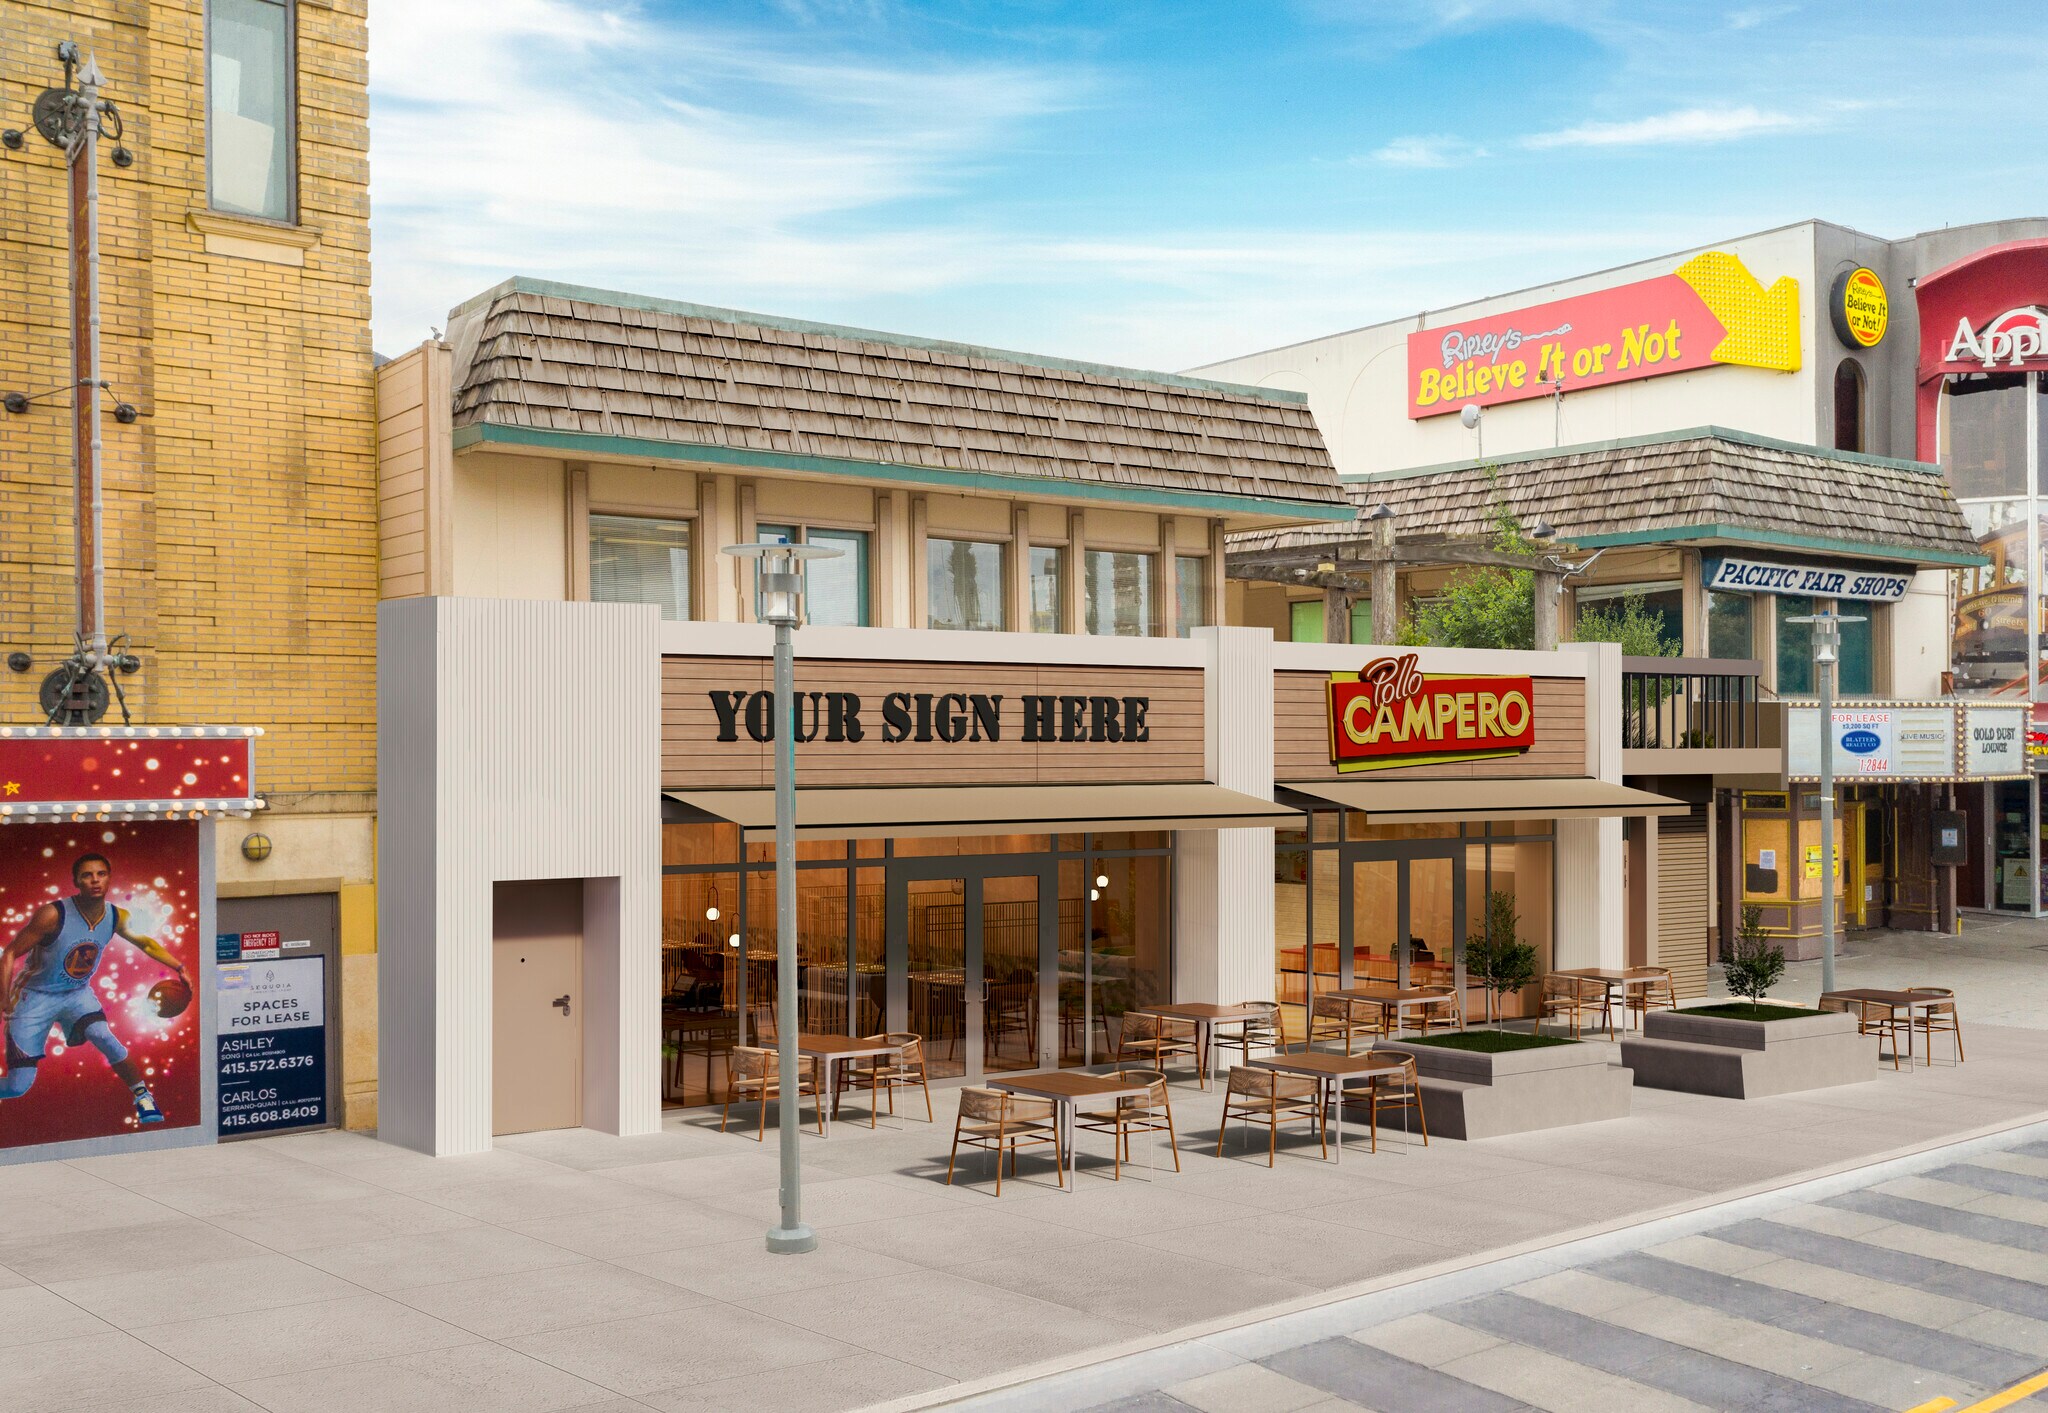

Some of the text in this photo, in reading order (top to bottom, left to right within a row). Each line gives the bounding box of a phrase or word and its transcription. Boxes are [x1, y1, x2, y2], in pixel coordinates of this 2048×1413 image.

[1847, 294, 1886, 317] Believe It
[1852, 315, 1880, 332] or Not!
[1416, 319, 1681, 406] Believe It or Not
[1718, 563, 1908, 597] PACIFIC FAIR SHOPS
[1995, 615, 2025, 626] Streets
[1358, 653, 1424, 708] Pollo
[708, 690, 1150, 743] YOUR SIGN HERE
[1341, 690, 1531, 745] CAMPERO
[1831, 714, 1889, 722] FOR LEASE
[1973, 727, 2016, 740] GOLD DUST
[1981, 742, 2008, 754] LOUNGE
[243, 938, 267, 948] EMERGENCY
[268, 937, 277, 947] EXIT
[250, 983, 292, 991] SEQUOIA
[243, 998, 298, 1012] SPACES
[232, 1011, 310, 1027] FOR LEASE
[221, 1037, 275, 1052] ASHLEY
[221, 1052, 241, 1060] SONG
[221, 1055, 314, 1074] 415.572.6376
[222, 1088, 277, 1104] CARLOS
[222, 1100, 277, 1112] SERRANO-QUAN
[222, 1105, 319, 1126] 415.608.8409
